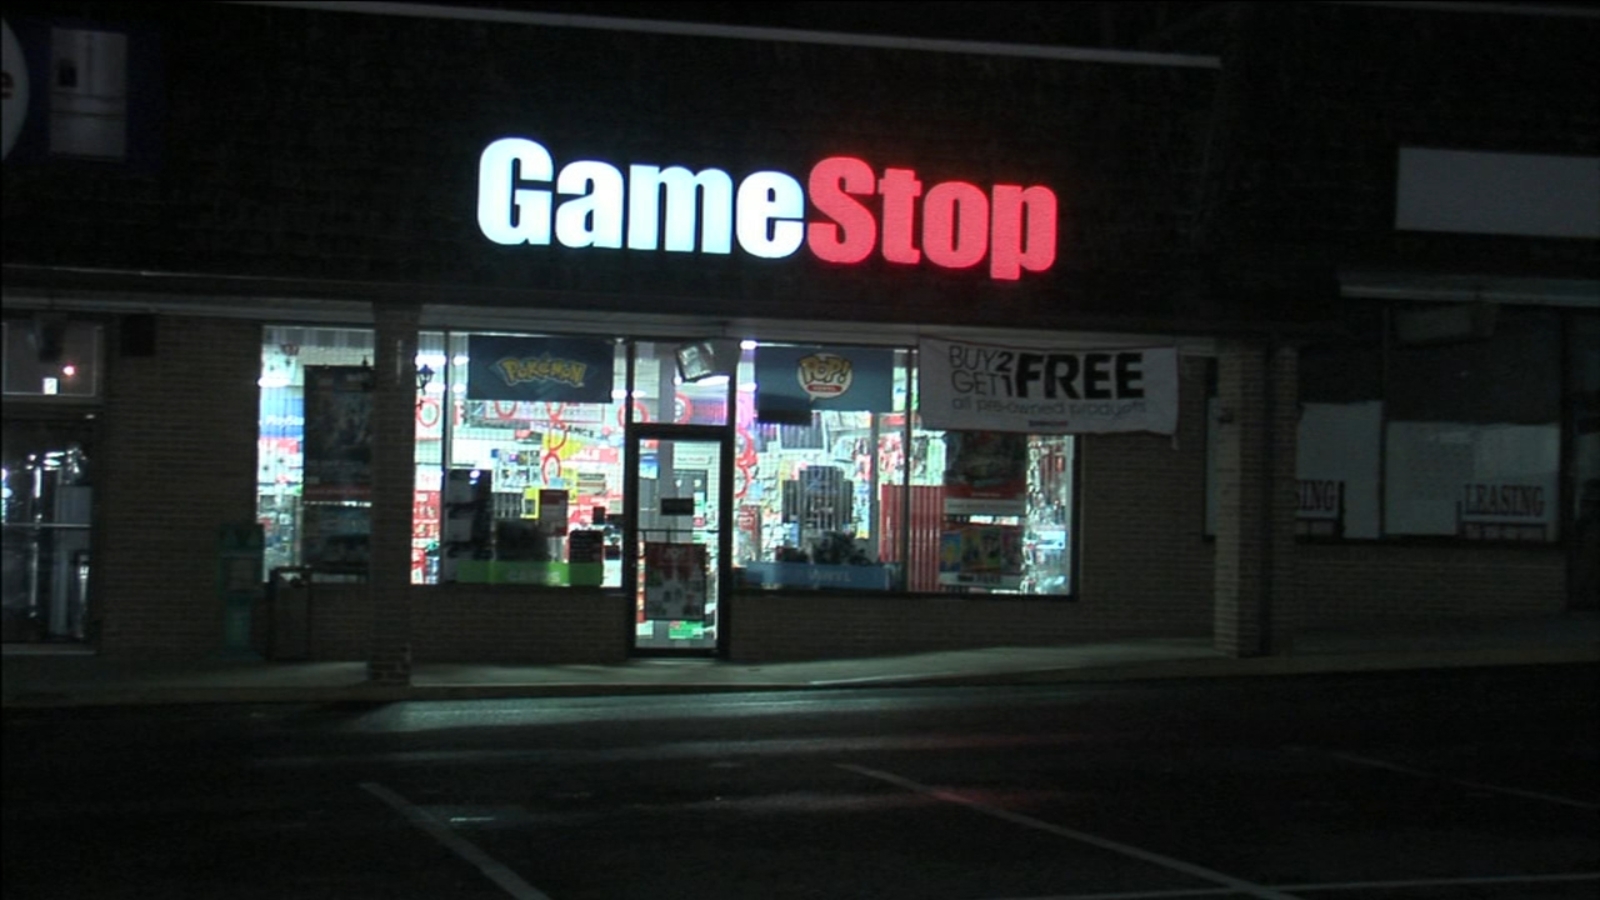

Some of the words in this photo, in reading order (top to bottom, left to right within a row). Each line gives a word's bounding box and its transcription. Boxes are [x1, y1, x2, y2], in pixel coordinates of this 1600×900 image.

[477, 137, 1058, 280] GameStop
[949, 345, 997, 371] BUY
[996, 351, 1013, 372] 2
[952, 370, 1000, 396] GET
[1015, 353, 1145, 399] FREE
[952, 398, 972, 411] all
[977, 400, 1064, 415] pre-owned
[1069, 402, 1147, 418] products
[1464, 484, 1545, 517] LEASING
